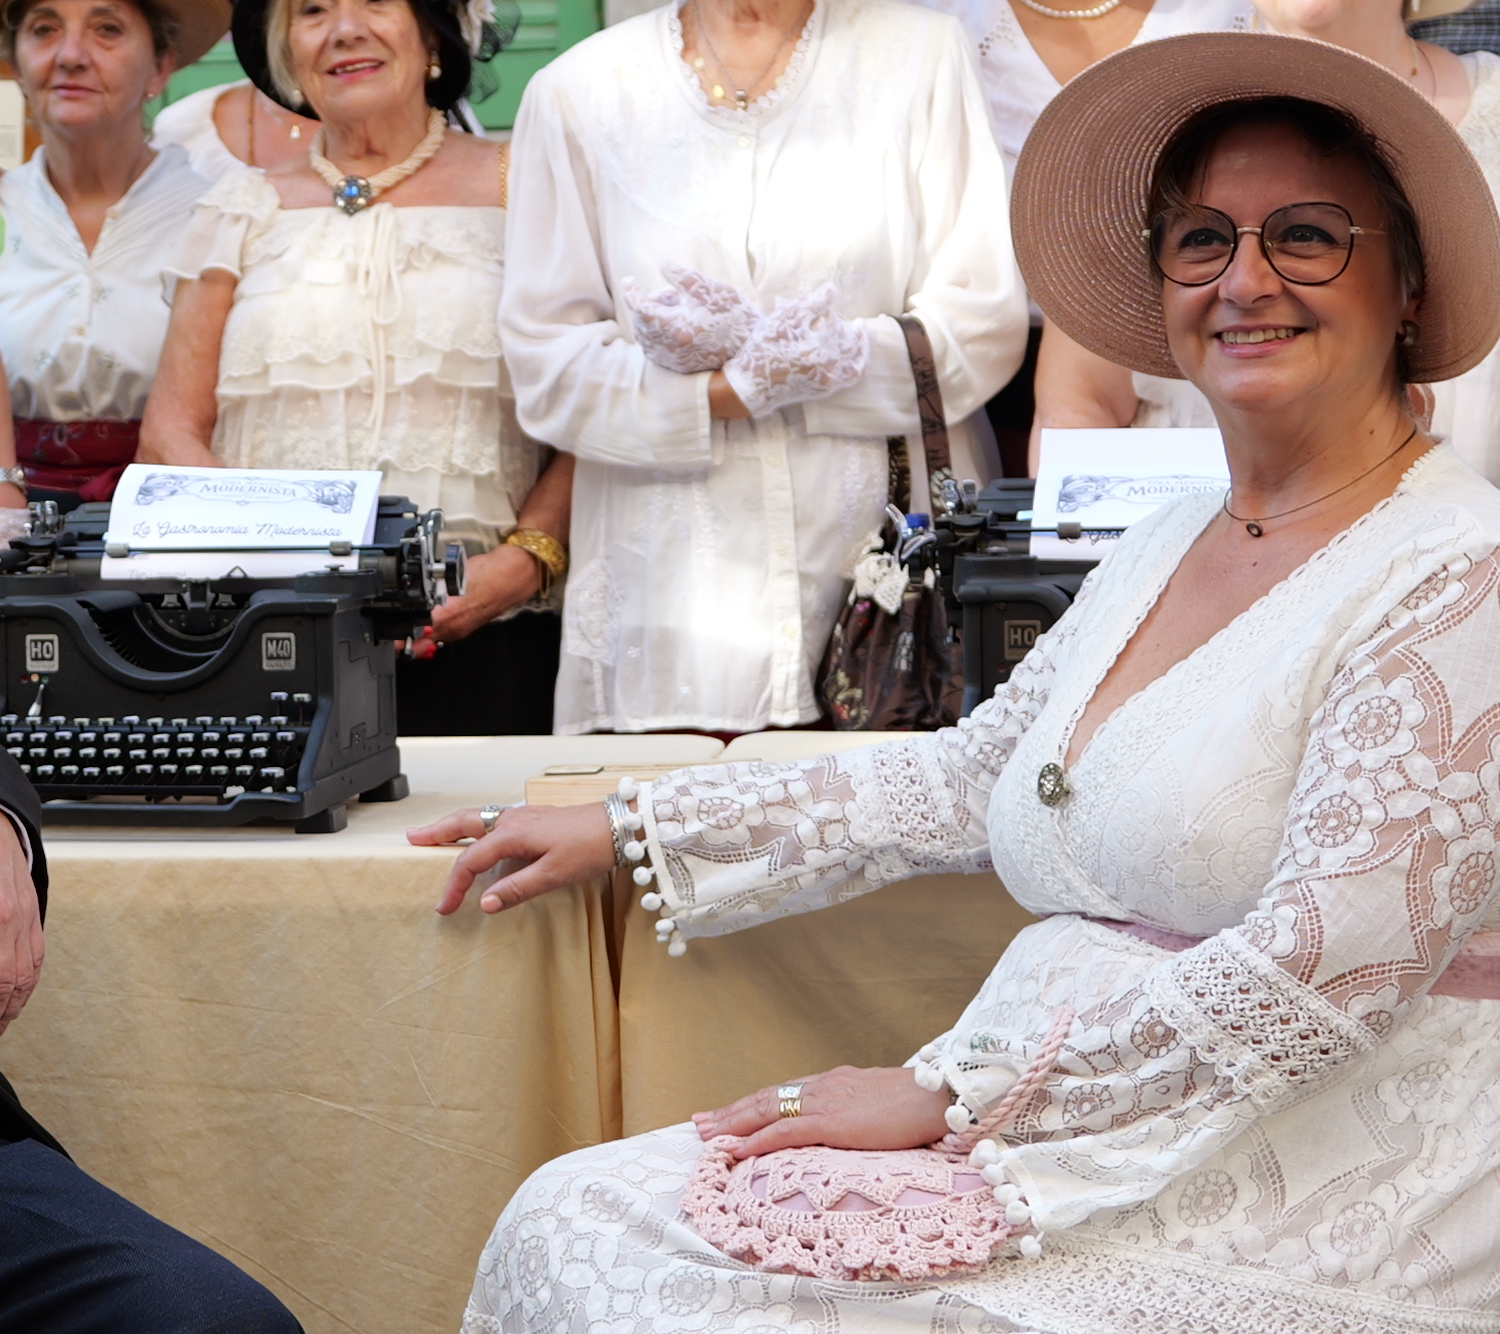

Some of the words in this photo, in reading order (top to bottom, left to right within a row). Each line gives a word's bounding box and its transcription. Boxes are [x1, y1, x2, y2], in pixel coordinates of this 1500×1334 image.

[200, 483, 297, 498] MODERNISTA
[131, 521, 151, 536] La
[255, 523, 342, 537] Modernista
[1010, 627, 1036, 646] HO
[31, 641, 53, 659] HO
[267, 639, 290, 658] M40
